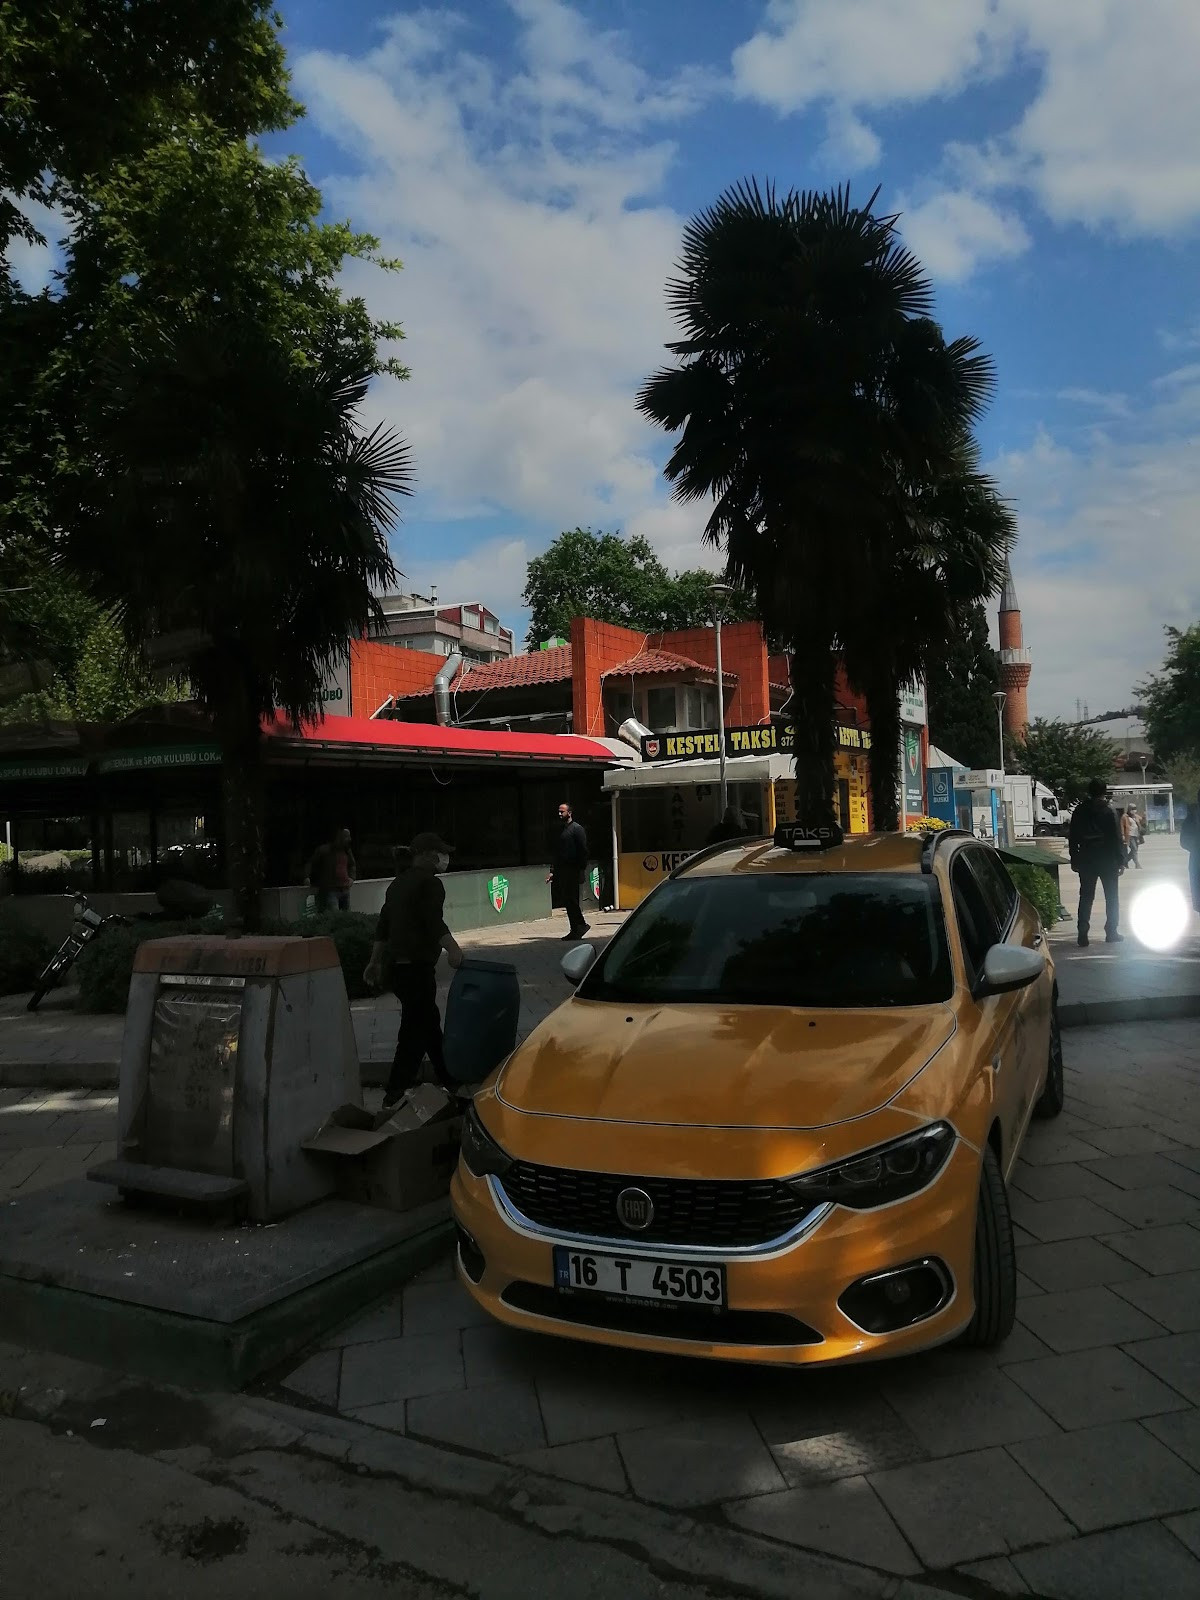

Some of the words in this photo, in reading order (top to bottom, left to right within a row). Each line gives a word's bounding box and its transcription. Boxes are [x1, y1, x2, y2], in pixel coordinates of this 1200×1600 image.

[730, 725, 778, 751] TAKSİ
[144, 756, 163, 766] SPOR
[624, 1199, 646, 1219] FIAT
[559, 1270, 569, 1279] TR
[571, 1255, 598, 1286] 16
[614, 1260, 632, 1291] T
[652, 1265, 721, 1301] 4503
